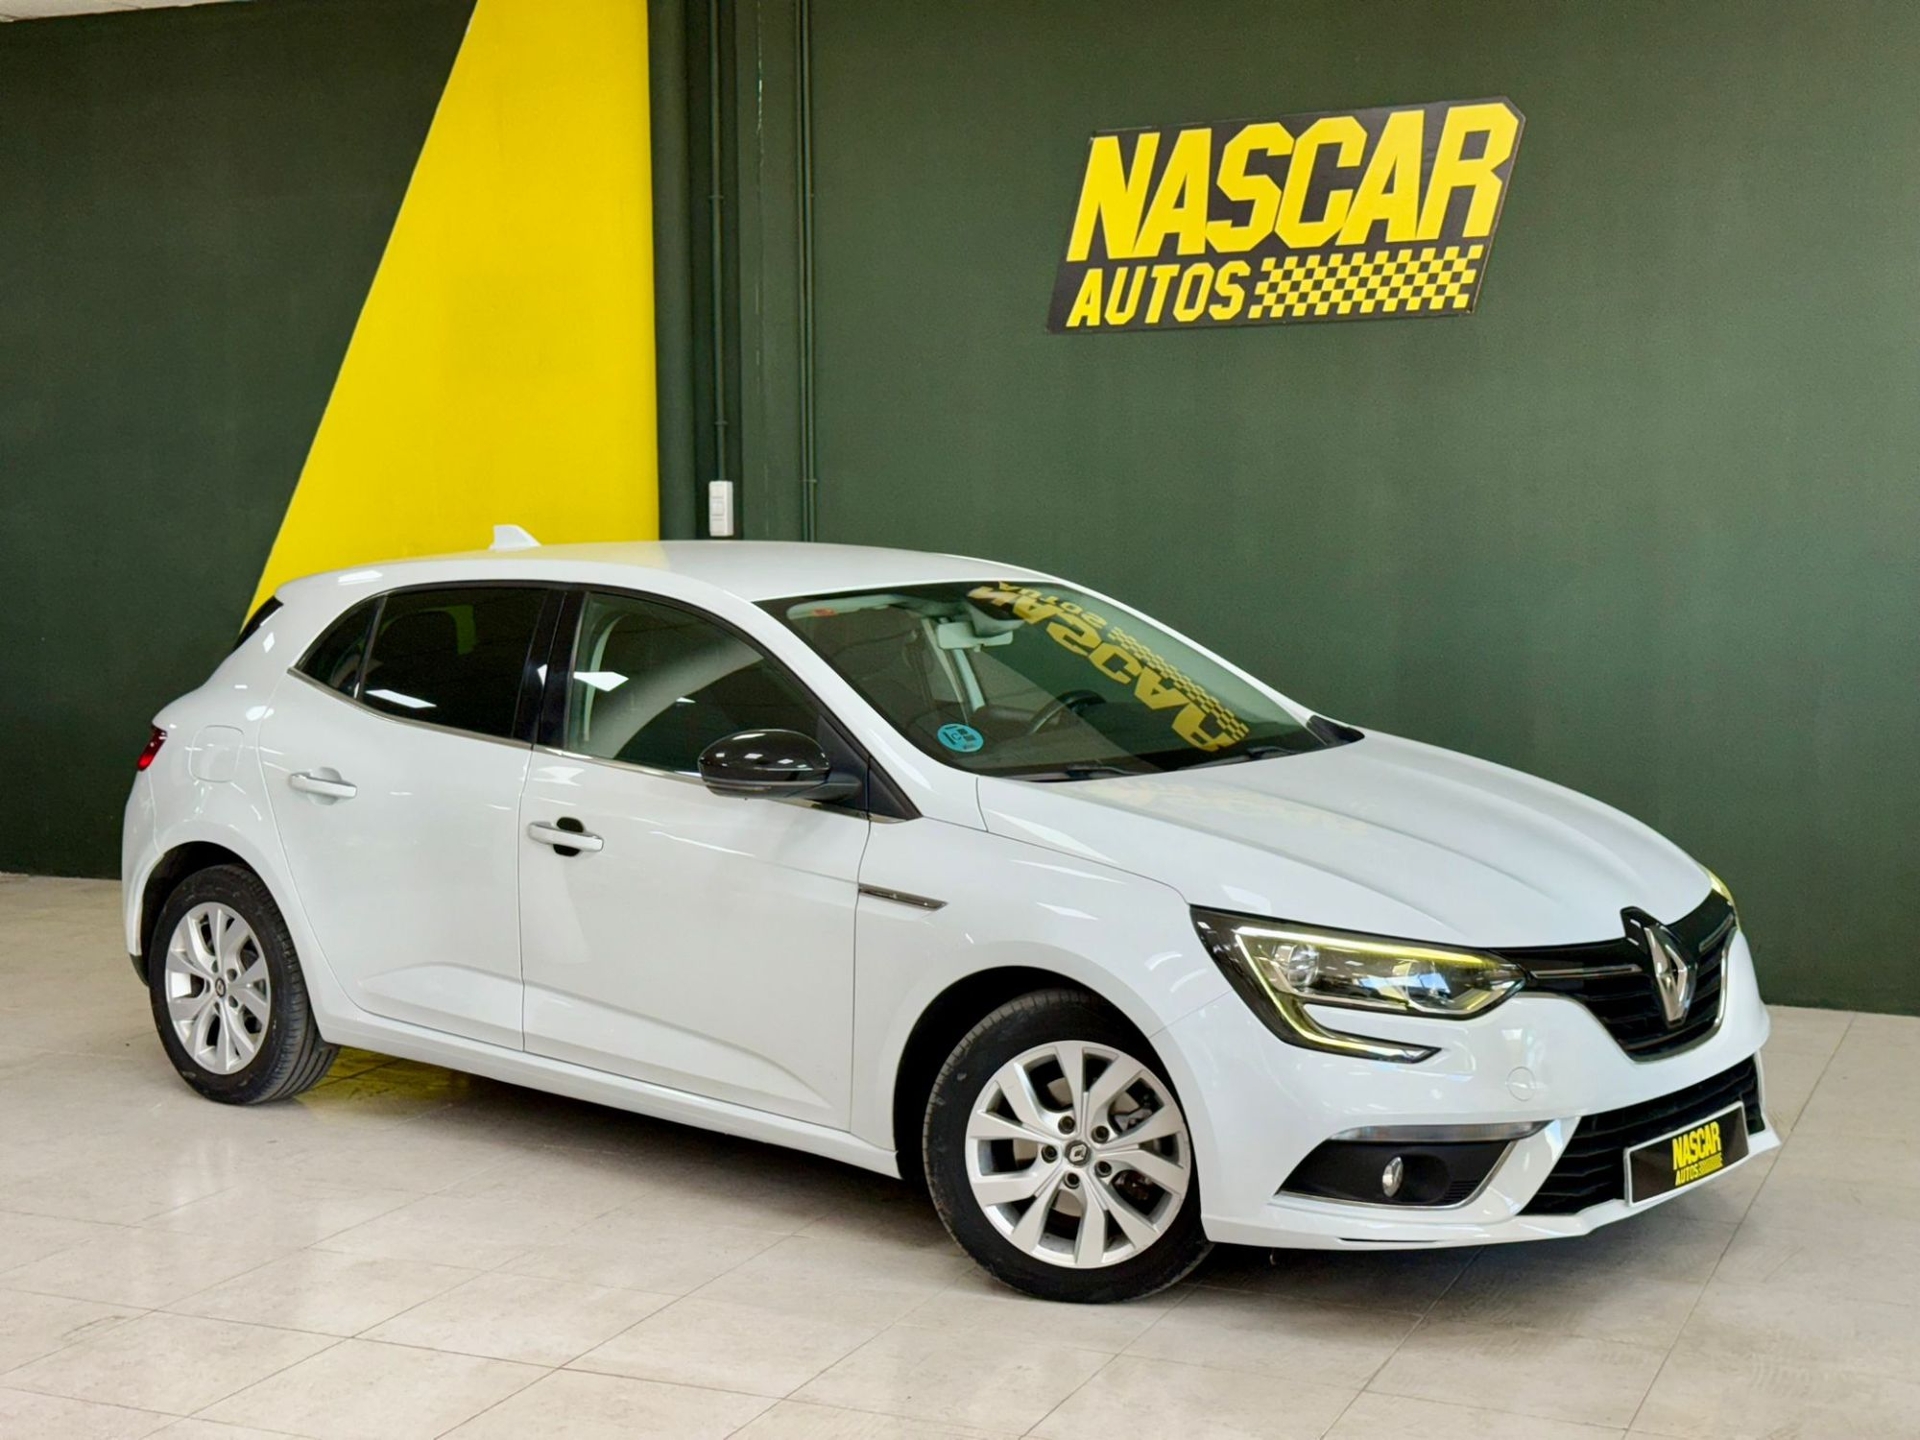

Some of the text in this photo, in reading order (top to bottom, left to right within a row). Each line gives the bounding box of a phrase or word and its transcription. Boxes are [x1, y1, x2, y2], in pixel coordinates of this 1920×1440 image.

[1066, 102, 1519, 261] NASCAR
[1066, 260, 1252, 327] AUTOS
[1672, 1121, 1722, 1170] NASCAR
[1675, 1163, 1699, 1186] AUTOS
